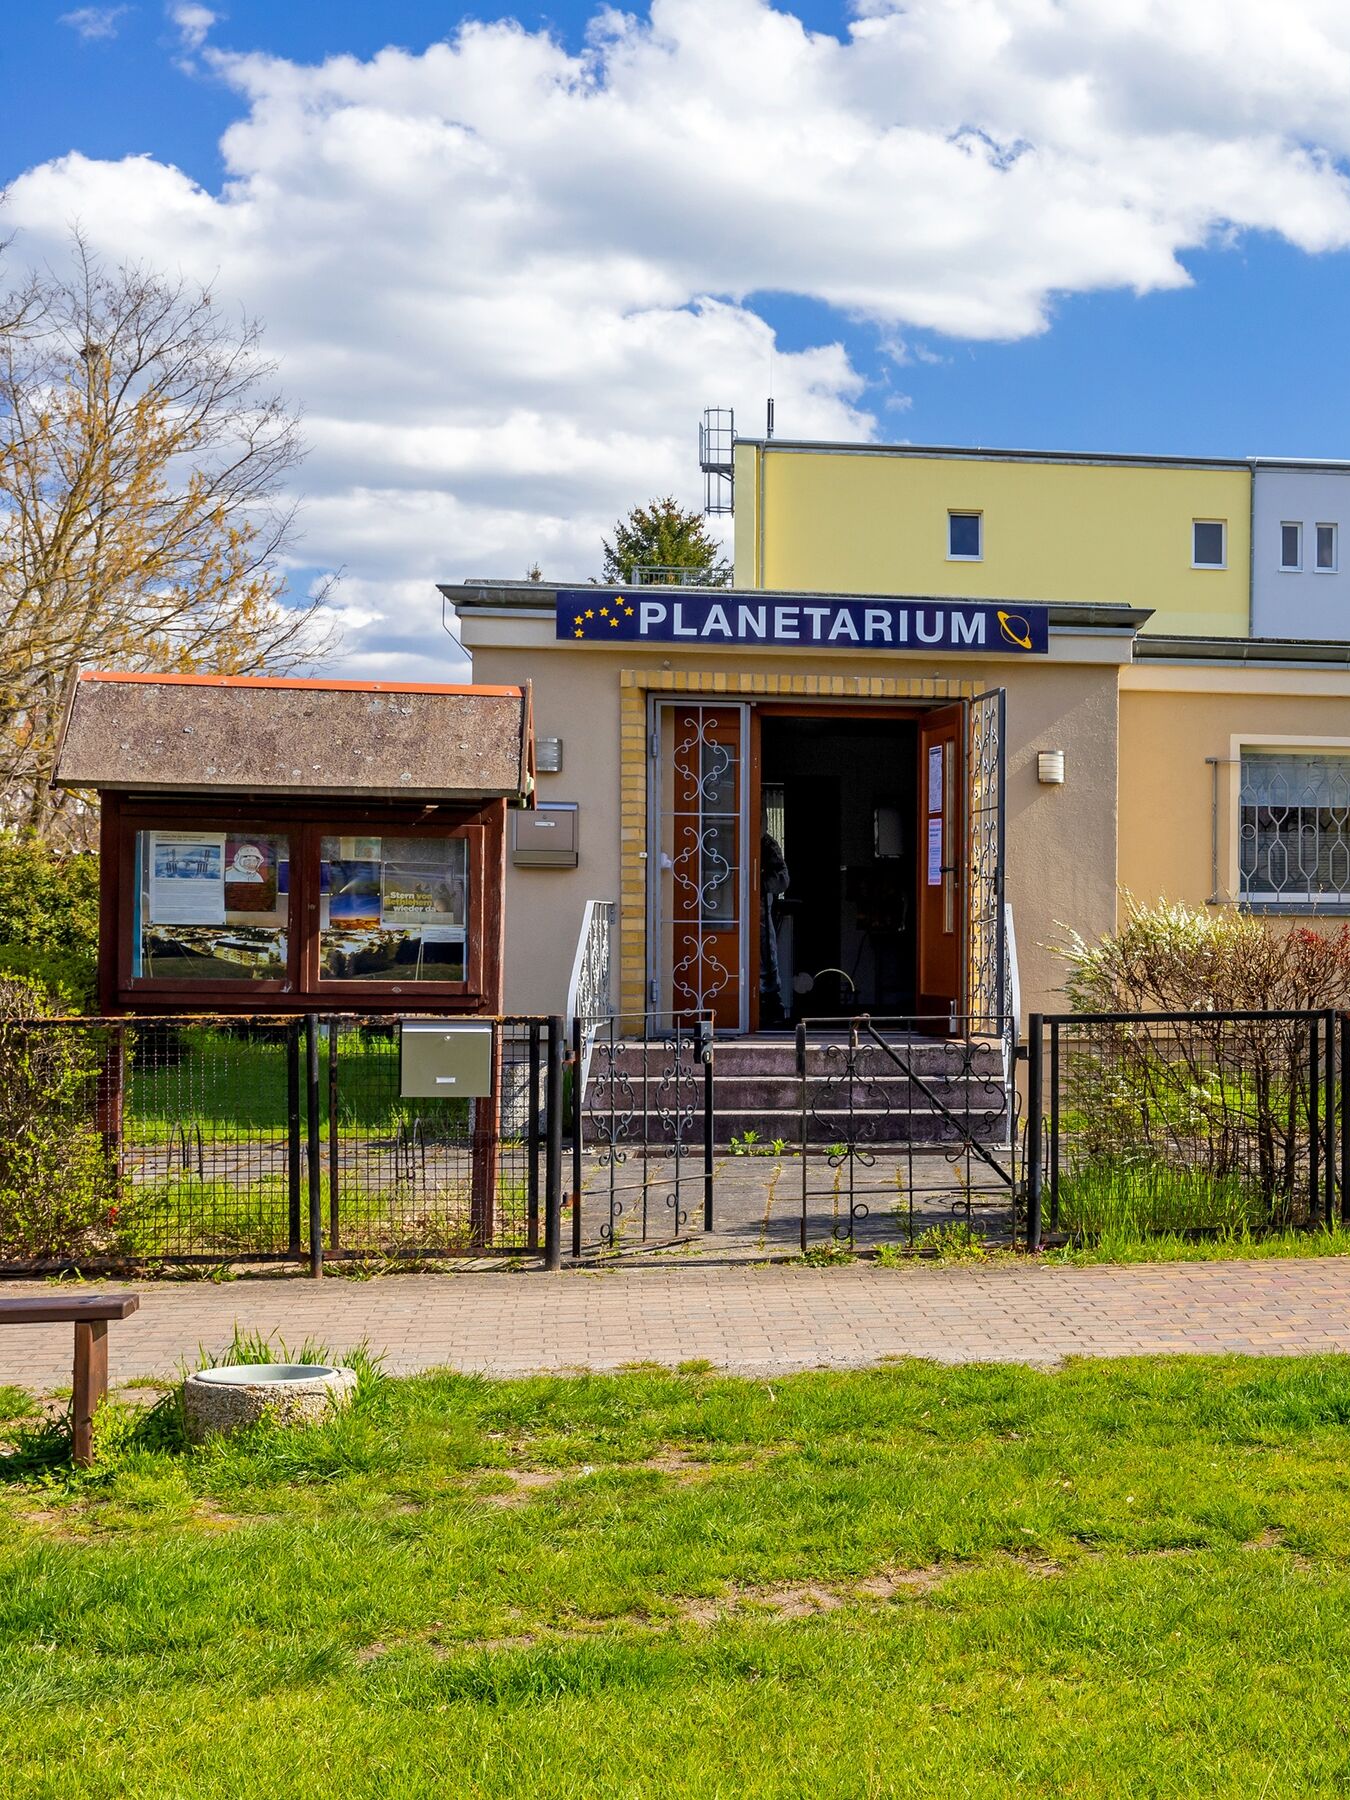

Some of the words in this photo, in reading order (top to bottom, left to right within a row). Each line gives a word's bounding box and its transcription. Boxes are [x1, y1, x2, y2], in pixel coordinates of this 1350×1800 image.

[639, 602, 986, 644] PLANETARIUM
[390, 891, 415, 899] Stern
[384, 898, 432, 906] Bethlehem
